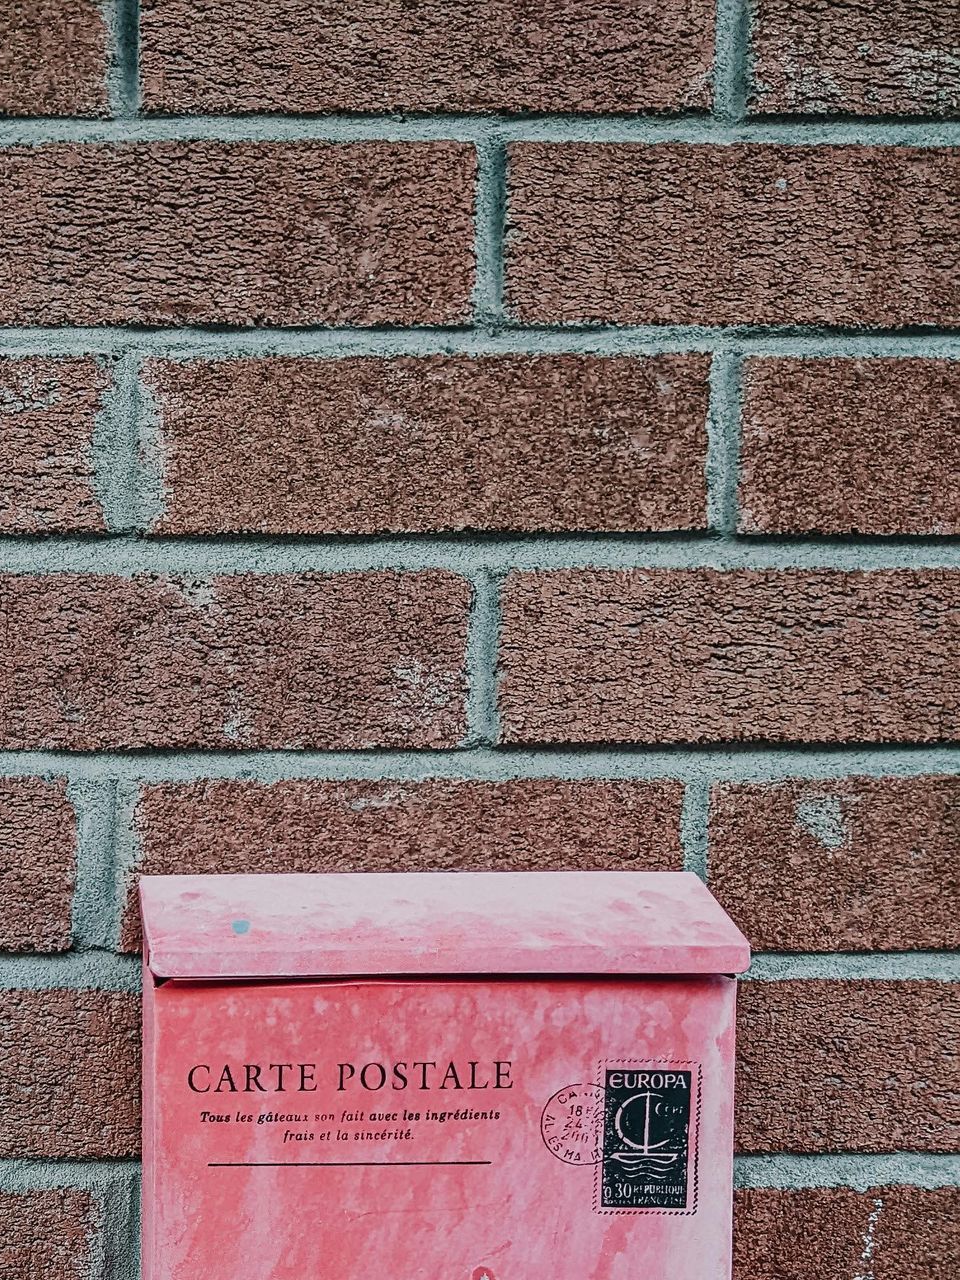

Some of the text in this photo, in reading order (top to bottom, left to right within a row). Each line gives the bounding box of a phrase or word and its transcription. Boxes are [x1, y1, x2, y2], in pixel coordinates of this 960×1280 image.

[187, 1061, 515, 1093] CARTE POSTALE
[609, 1073, 687, 1089] EUROPA
[199, 1111, 231, 1123] Tous
[235, 1111, 253, 1123] les
[314, 1113, 335, 1121] son
[340, 1110, 365, 1123] fait
[368, 1113, 398, 1122] avec
[402, 1109, 421, 1122] les
[425, 1108, 501, 1123] ingrédients
[283, 1128, 415, 1143] frais et la sincérité.
